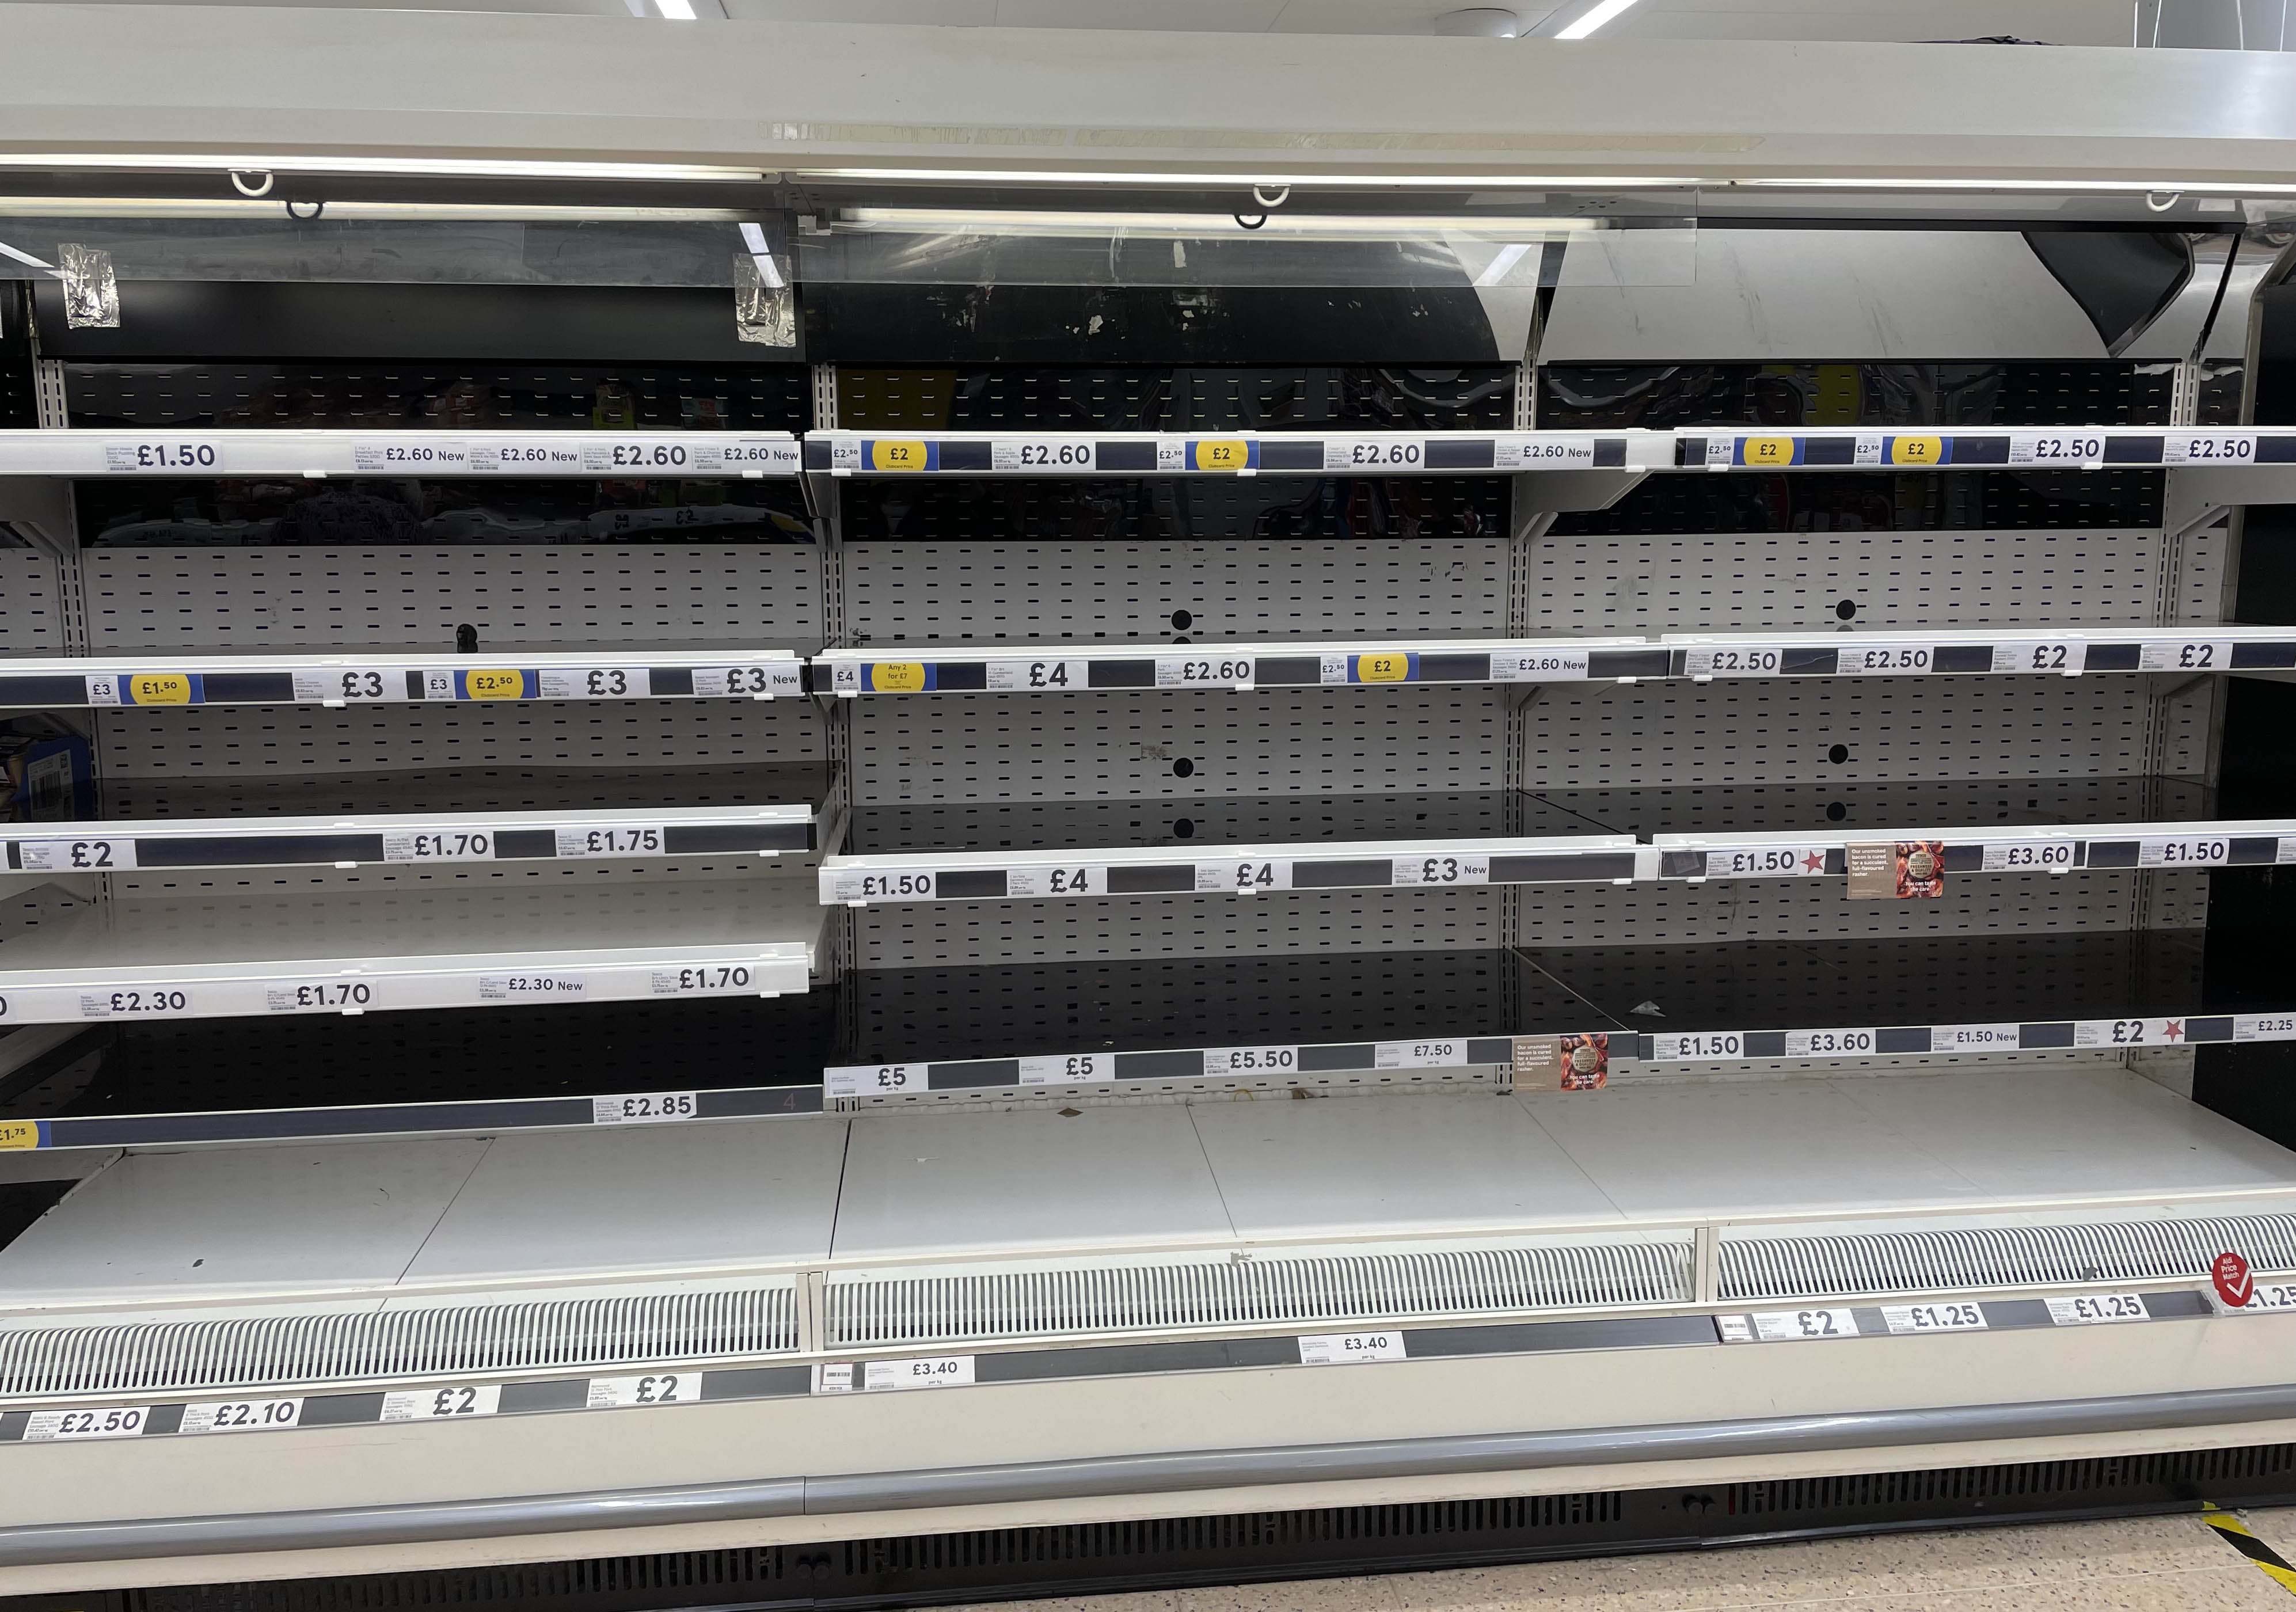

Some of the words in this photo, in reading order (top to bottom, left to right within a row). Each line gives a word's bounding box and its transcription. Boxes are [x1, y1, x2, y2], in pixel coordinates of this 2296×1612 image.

[138, 445, 215, 466] £1.50
[386, 448, 432, 460] £2.60
[439, 451, 464, 461] New
[501, 448, 546, 461] £2.60
[552, 451, 577, 461] New
[613, 446, 686, 465] £2.60
[724, 448, 768, 460] £2.60
[774, 451, 798, 459] New
[891, 448, 908, 460] £2
[1021, 446, 1090, 465] £2.60
[1213, 448, 1230, 459] £2
[1352, 445, 1419, 463] £2.60
[1523, 446, 1564, 457] £2.60
[1568, 448, 1591, 457] New
[1760, 444, 1776, 455] £2
[1908, 443, 1924, 454] £2
[2036, 439, 2099, 457] £2.50
[2189, 440, 2250, 458] £2.50
[1519, 659, 1558, 670] £2.60
[1564, 661, 1586, 669] New
[1712, 653, 1776, 670] £2.50
[1864, 651, 1928, 668] £2.50
[2032, 645, 2066, 668] £2
[2179, 645, 2213, 667] £2
[1029, 663, 1068, 687] £4
[1184, 661, 1249, 680] £2.60
[1375, 660, 1390, 672] £2
[342, 672, 383, 697] £3
[431, 679, 447, 689] £3
[477, 677, 512, 689] £2.50
[587, 670, 626, 695] £3
[727, 668, 766, 694] £3
[773, 675, 797, 684] New
[837, 671, 853, 681] £4
[93, 685, 111, 695] £3
[143, 682, 177, 694] £1.50
[415, 835, 488, 856] £1.70
[587, 830, 658, 851] £1.75
[71, 842, 113, 867] £2
[2008, 846, 2069, 865] £3.60
[2164, 842, 2224, 861] £1.50
[1423, 858, 1457, 882] £3
[1465, 866, 1487, 874] New
[1732, 851, 1794, 872] £1.50
[863, 875, 930, 895] £1.50
[1050, 869, 1088, 893] £4
[1237, 864, 1274, 887] £4
[509, 979, 553, 990] £2.30
[558, 982, 583, 990] New
[679, 967, 748, 989] £1.70
[111, 992, 185, 1011] £2.30
[297, 984, 370, 1006] £1.70
[2112, 1021, 2143, 1043] £2
[2259, 1020, 2293, 1031] £2.25
[1679, 1036, 1738, 1055] £1.50
[1811, 1033, 1869, 1051] £3.60
[1957, 1031, 1992, 1042] £1.50
[1415, 1044, 1452, 1056] £7.50
[1066, 1057, 1093, 1075] £5
[1230, 1051, 1293, 1069] £5.50
[879, 1067, 906, 1086] £5
[623, 1096, 691, 1117] £2.85
[2221, 1265, 2237, 1273] Price
[2222, 1257, 2233, 1265] Aldi
[2223, 1272, 2240, 1280] Match
[1911, 1305, 1979, 1326] £1.25
[2075, 1297, 2141, 1318] £1.25
[1798, 1311, 1838, 1336] £2
[1345, 1337, 1387, 1349] £3.40
[913, 1362, 957, 1375] £3.40
[636, 1376, 678, 1403] £2
[433, 1387, 476, 1415] £2
[59, 1410, 140, 1434] £2.50
[214, 1402, 294, 1426] £2.10
